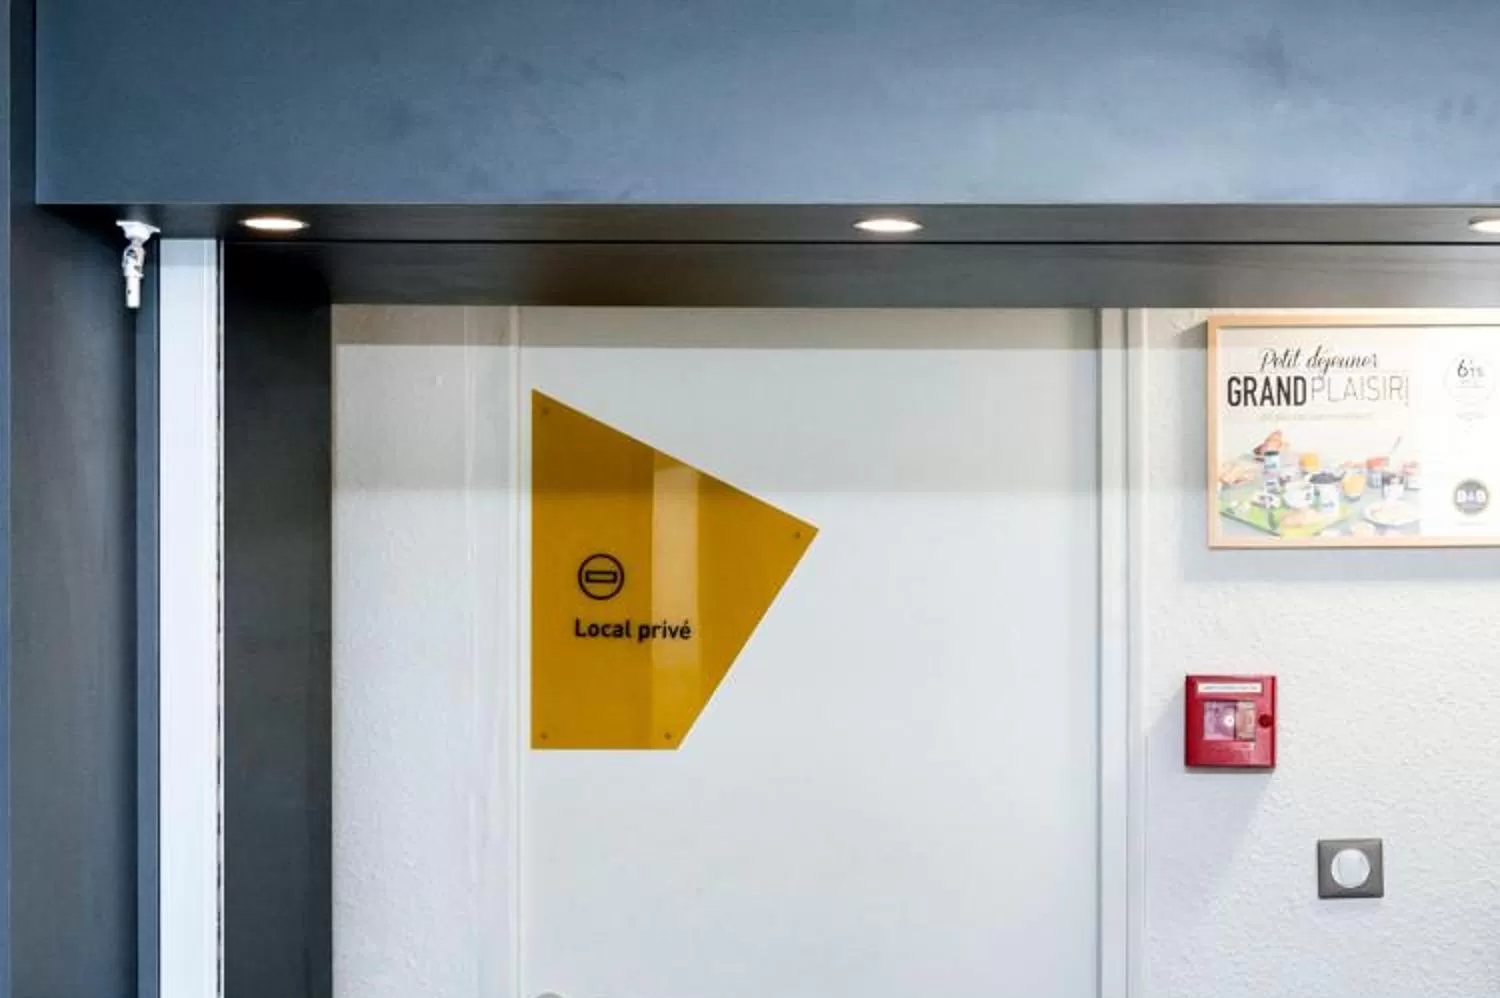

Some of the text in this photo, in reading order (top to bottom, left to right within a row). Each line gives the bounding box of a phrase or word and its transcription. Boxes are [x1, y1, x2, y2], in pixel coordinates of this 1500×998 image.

[1261, 348, 1301, 373] Petit
[1227, 375, 1307, 407] GRAND
[575, 618, 692, 643] Local privé
